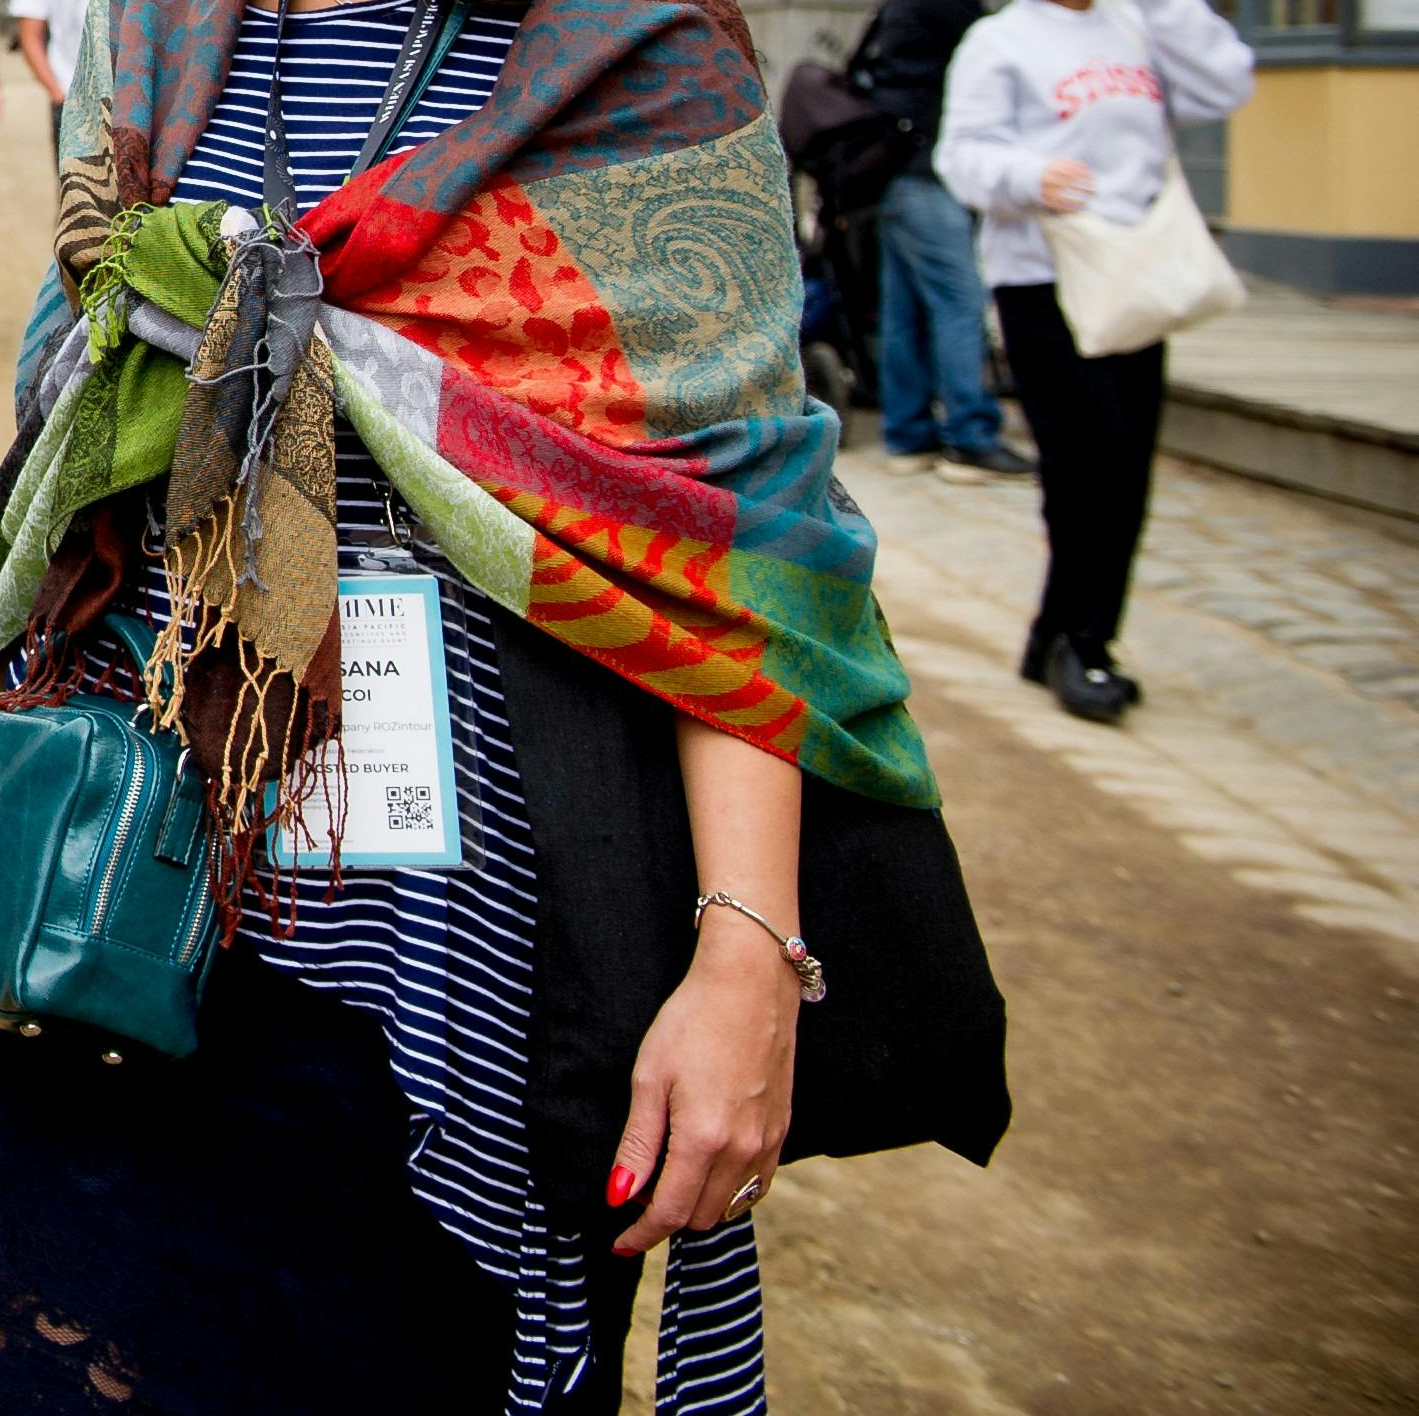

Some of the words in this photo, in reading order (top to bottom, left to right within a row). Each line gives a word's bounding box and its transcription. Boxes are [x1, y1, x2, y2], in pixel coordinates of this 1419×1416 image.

[341, 660, 400, 677] SANA
[341, 688, 371, 702] COI
[342, 724, 370, 734] pany
[363, 764, 409, 774] BUYER
